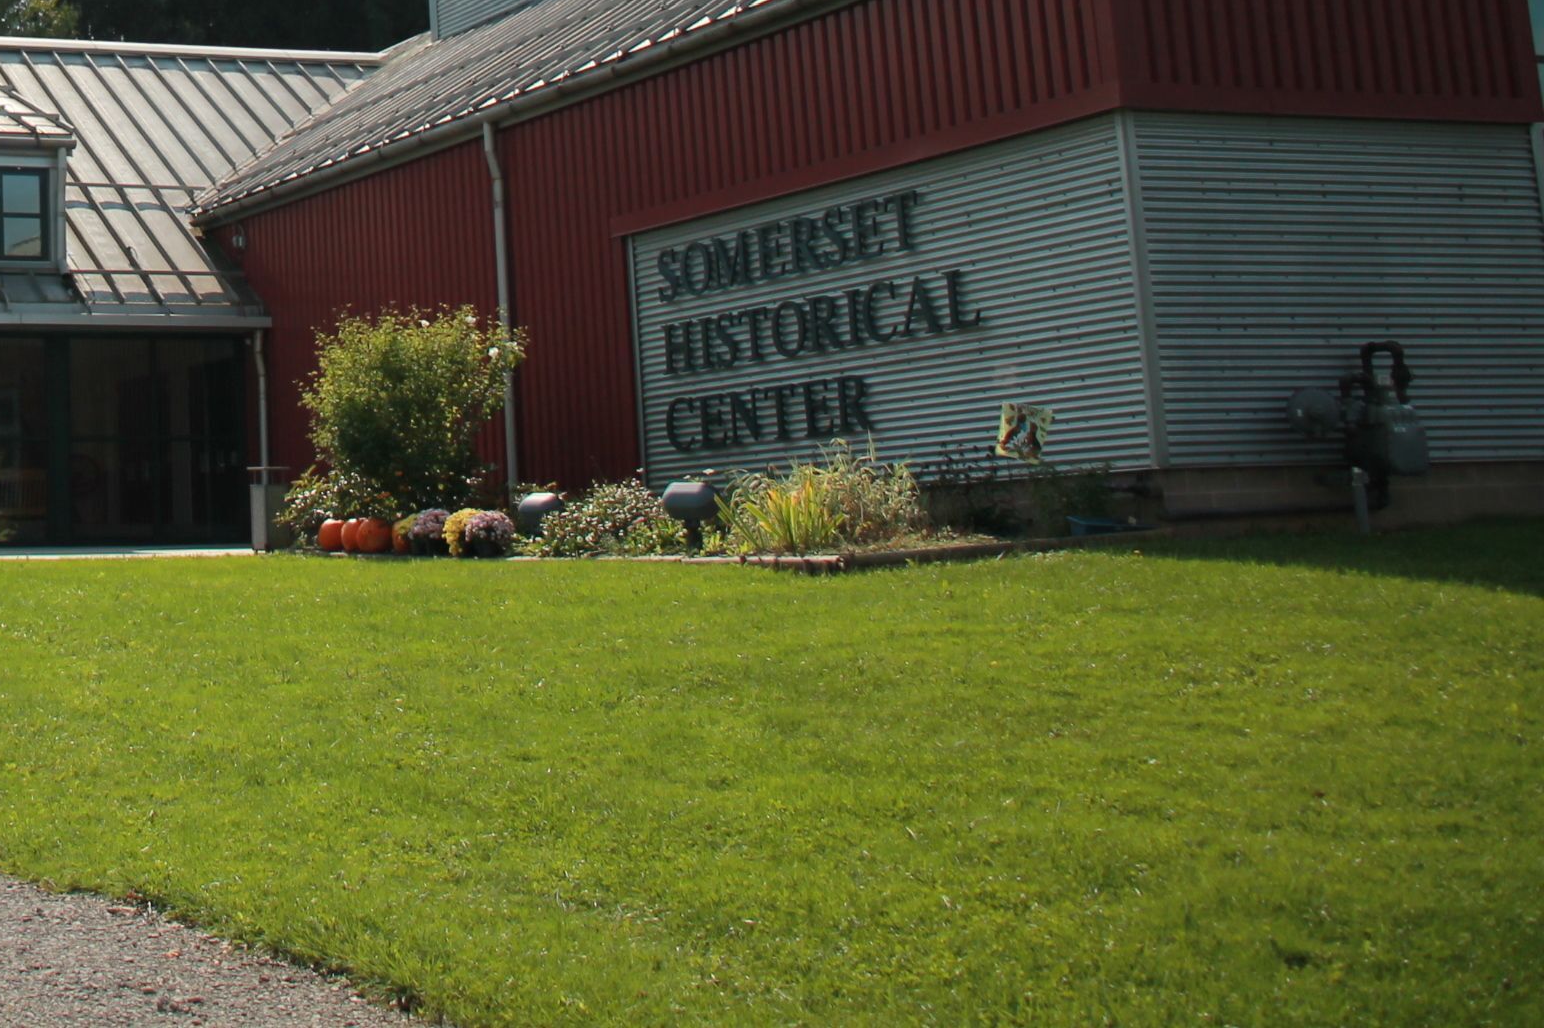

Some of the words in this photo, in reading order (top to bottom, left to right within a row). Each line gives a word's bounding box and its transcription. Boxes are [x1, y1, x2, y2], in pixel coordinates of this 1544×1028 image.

[658, 191, 919, 302] SOMERSET
[662, 270, 981, 375] HISTORICAL
[666, 375, 874, 452] CENTER
